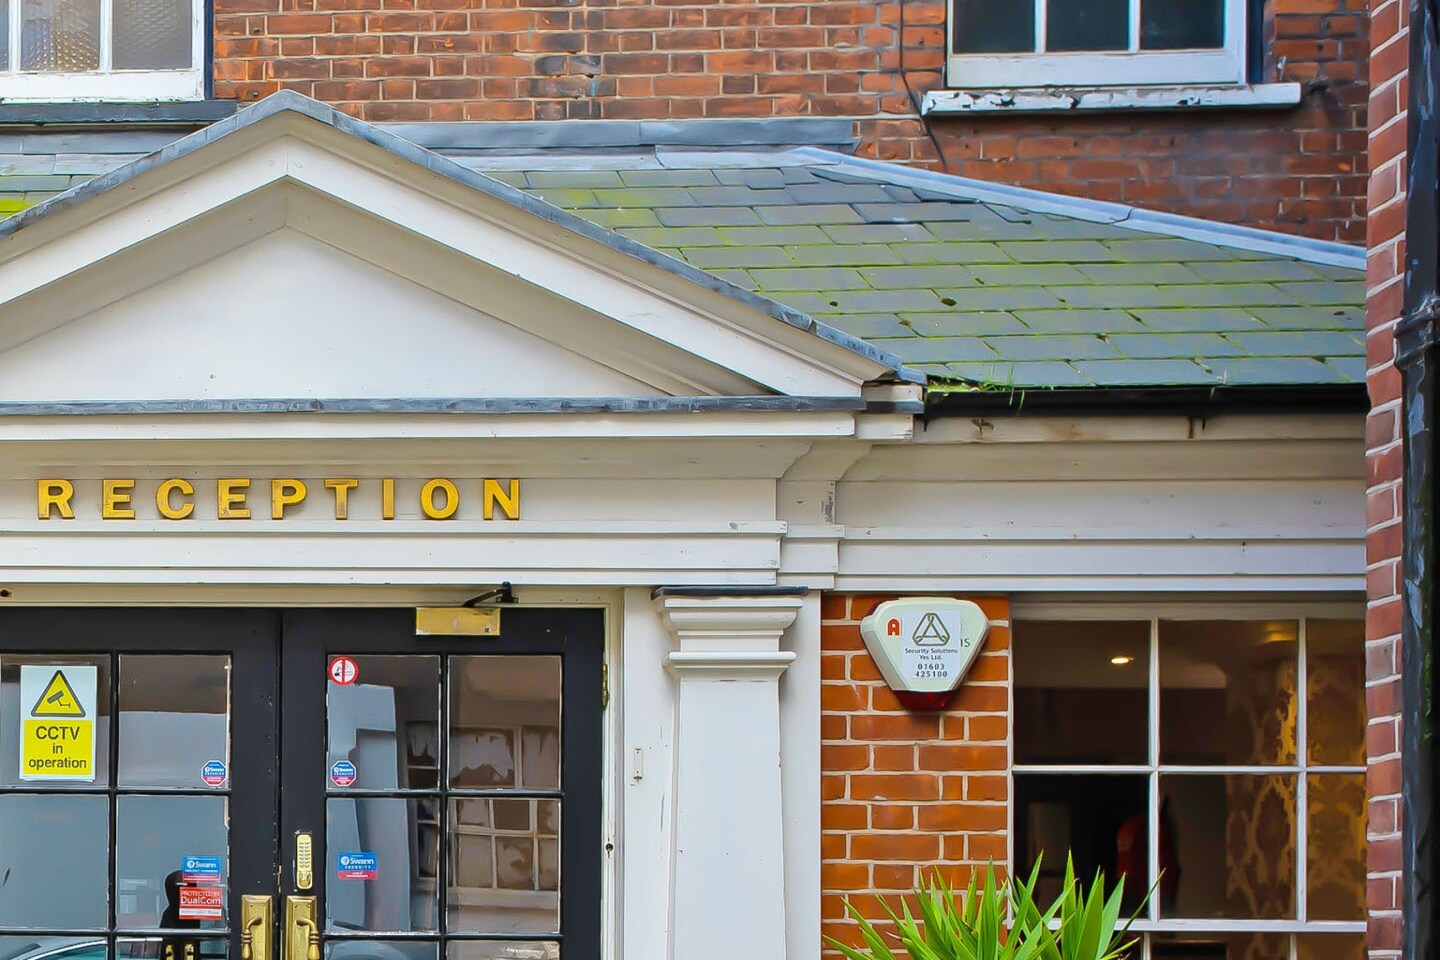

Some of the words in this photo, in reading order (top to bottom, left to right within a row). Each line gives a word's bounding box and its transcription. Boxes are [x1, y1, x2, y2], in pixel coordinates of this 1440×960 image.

[37, 478, 521, 521] RECEPTION
[35, 725, 81, 741] CCTV
[52, 742, 64, 754] in
[28, 757, 87, 771] operation
[195, 860, 217, 868] Swann
[350, 857, 375, 865] Swann
[181, 896, 221, 905] DualCom
